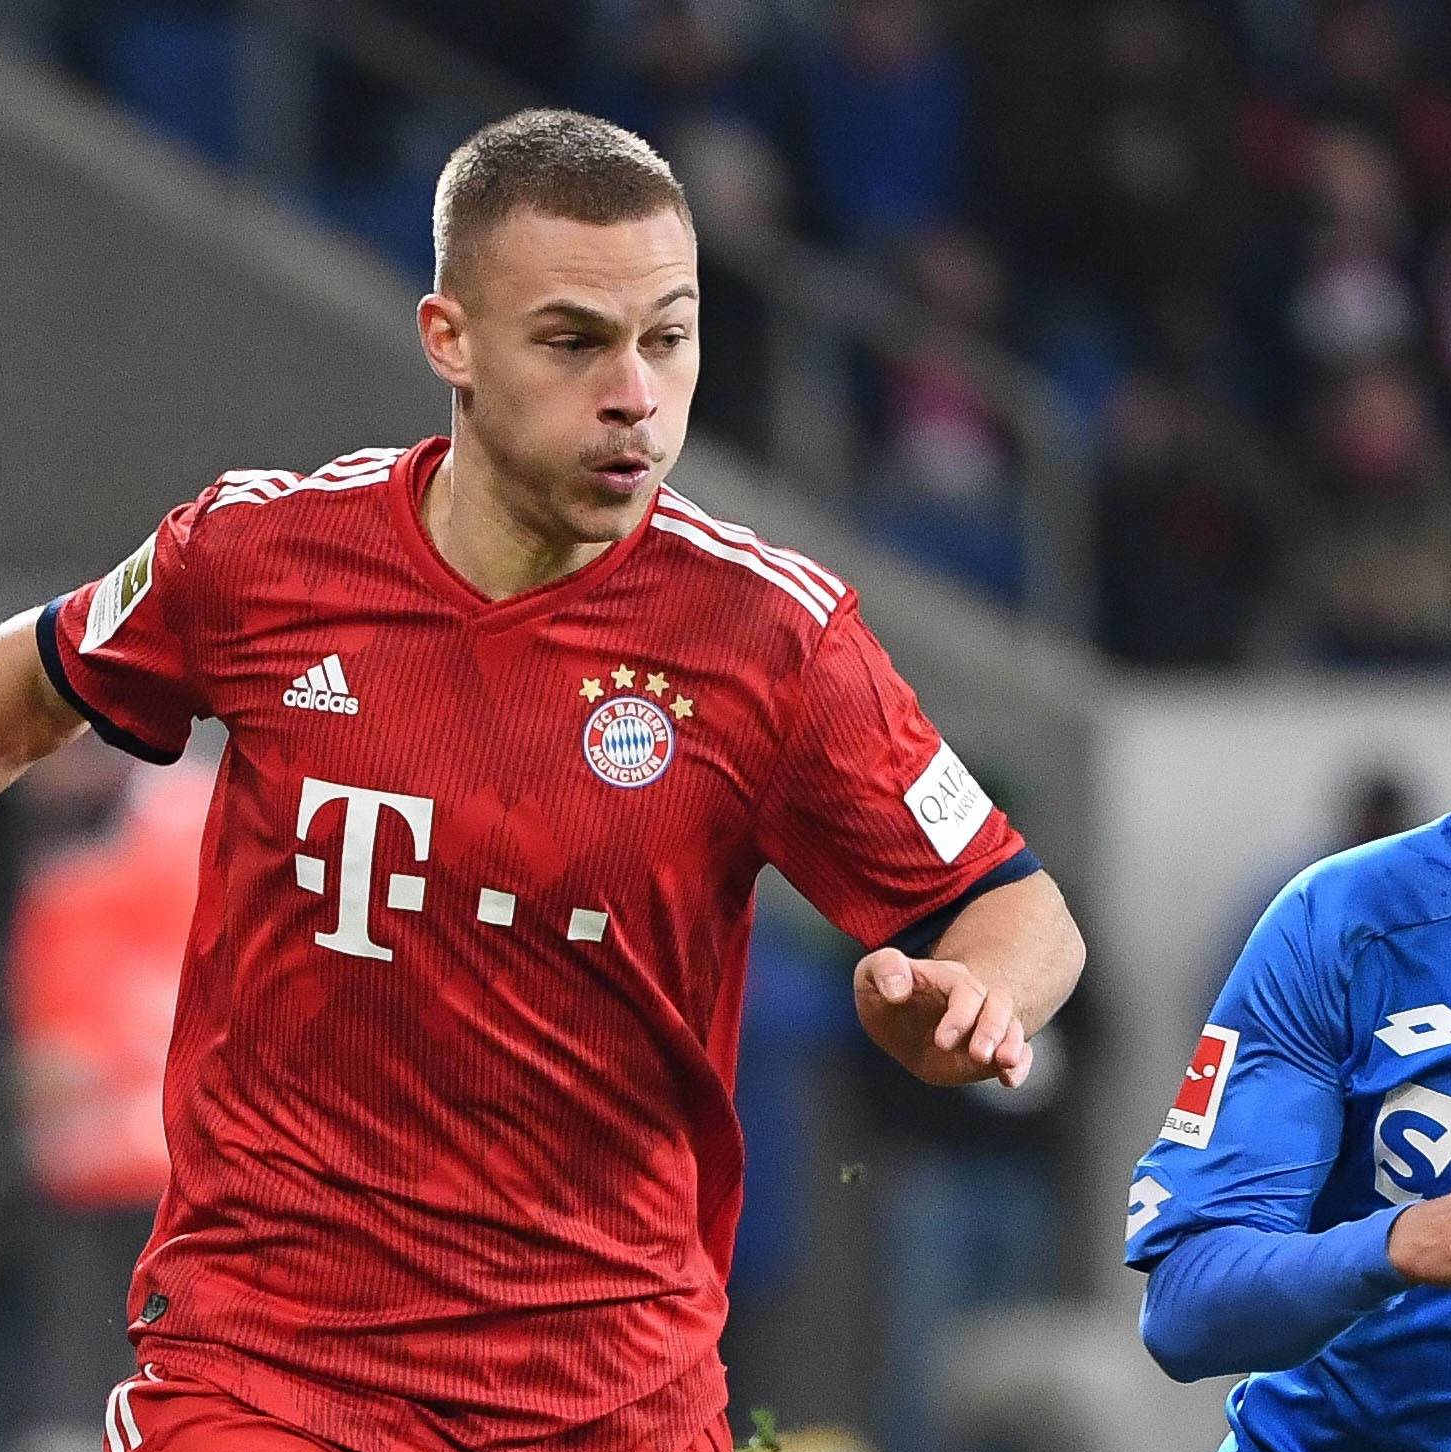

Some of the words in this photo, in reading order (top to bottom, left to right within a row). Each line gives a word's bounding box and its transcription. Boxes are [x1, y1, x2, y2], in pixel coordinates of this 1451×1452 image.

[282, 687, 359, 715] adidas
[593, 710, 612, 732] FC
[614, 703, 666, 742] BAYERN
